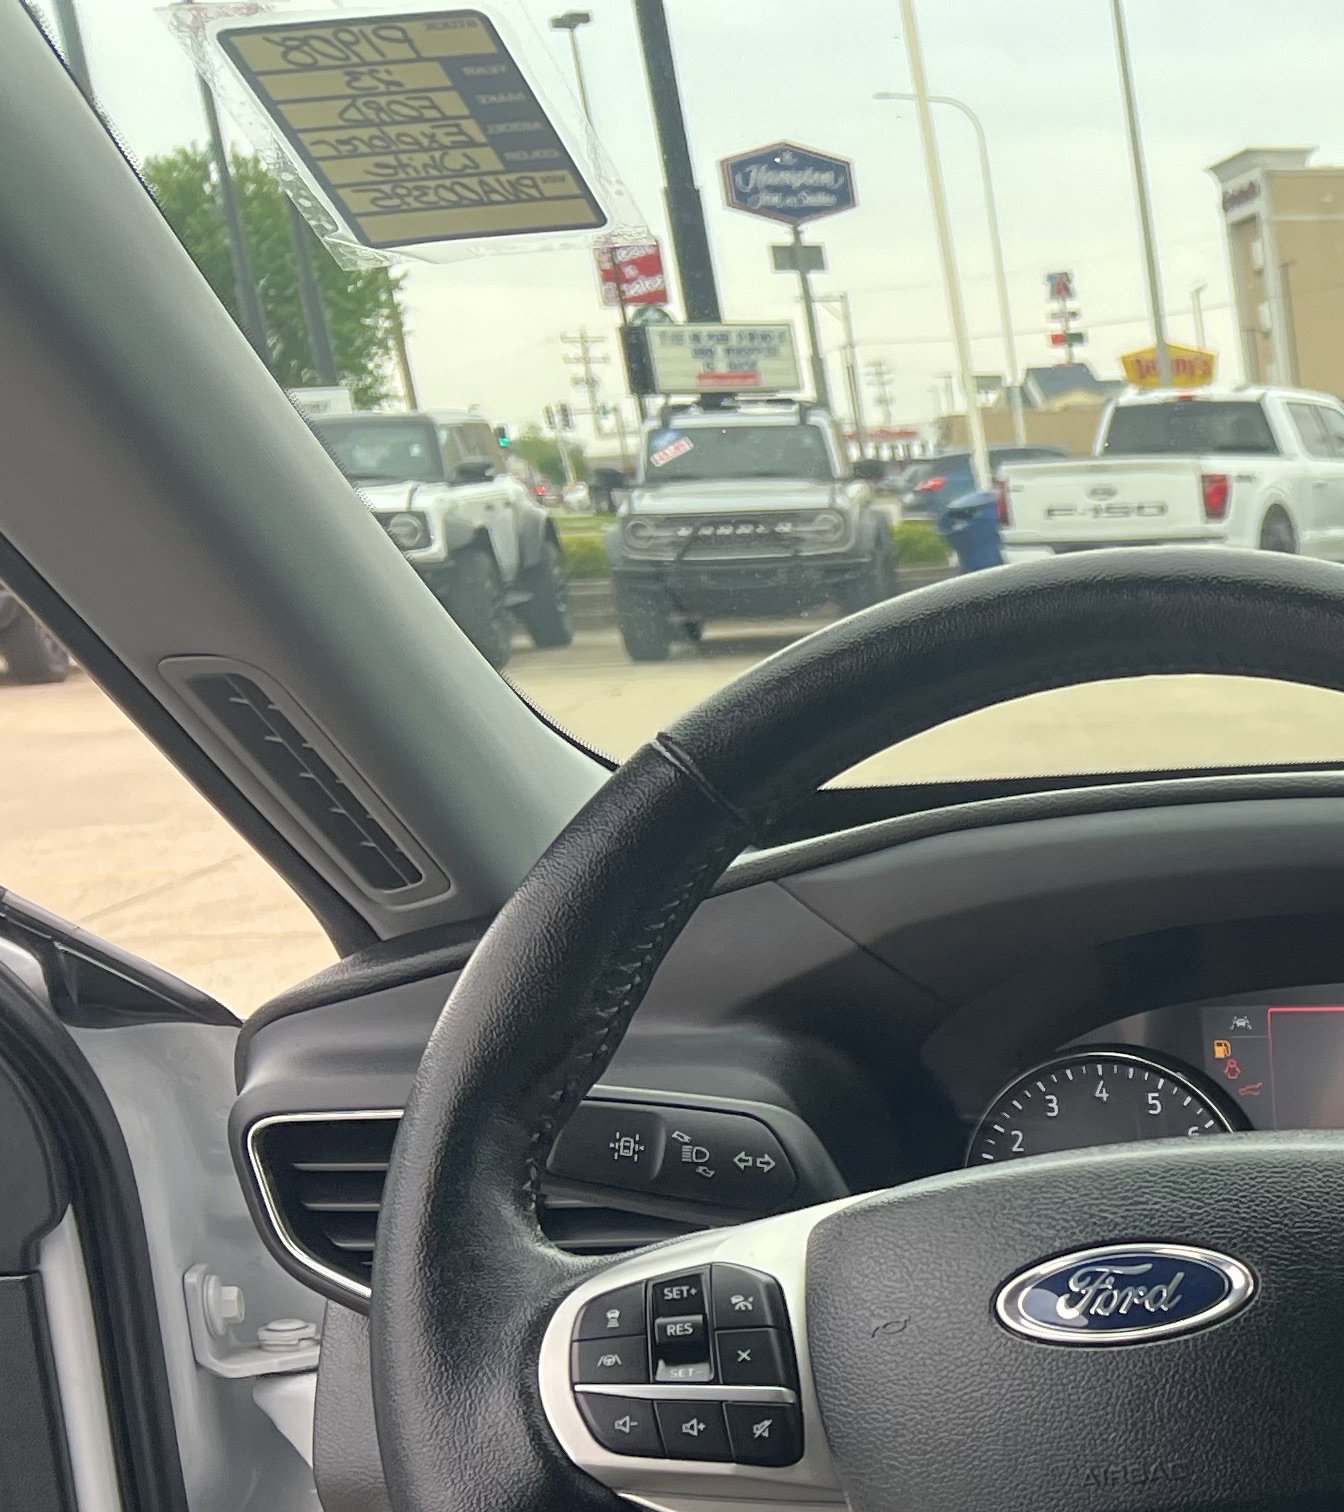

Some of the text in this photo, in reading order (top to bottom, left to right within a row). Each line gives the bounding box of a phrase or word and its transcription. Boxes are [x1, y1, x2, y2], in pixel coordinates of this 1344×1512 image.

[1094, 1080, 1109, 1103] 4
[1044, 1094, 1059, 1117] 3
[1147, 1092, 1162, 1115] 5
[1010, 1130, 1025, 1152] 2
[1056, 1262, 1186, 1320] Ford
[666, 1322, 694, 1337] RES
